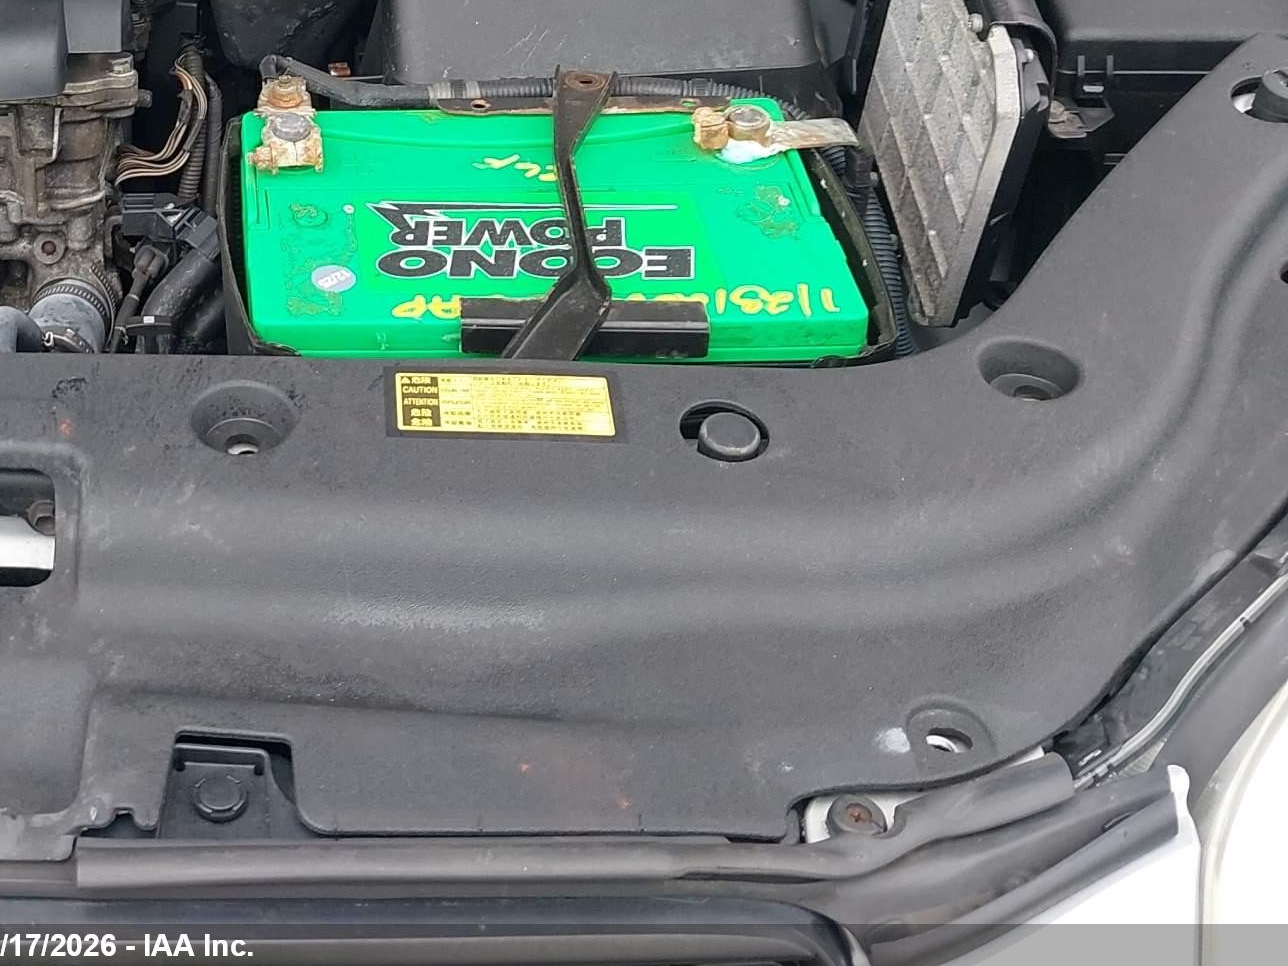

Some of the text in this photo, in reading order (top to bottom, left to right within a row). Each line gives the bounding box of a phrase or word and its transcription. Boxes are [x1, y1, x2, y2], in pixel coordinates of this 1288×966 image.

[388, 217, 626, 248] POWER
[376, 246, 695, 280] ECONO
[402, 385, 438, 395] CAUTION
[403, 398, 439, 406] ATTENTION
